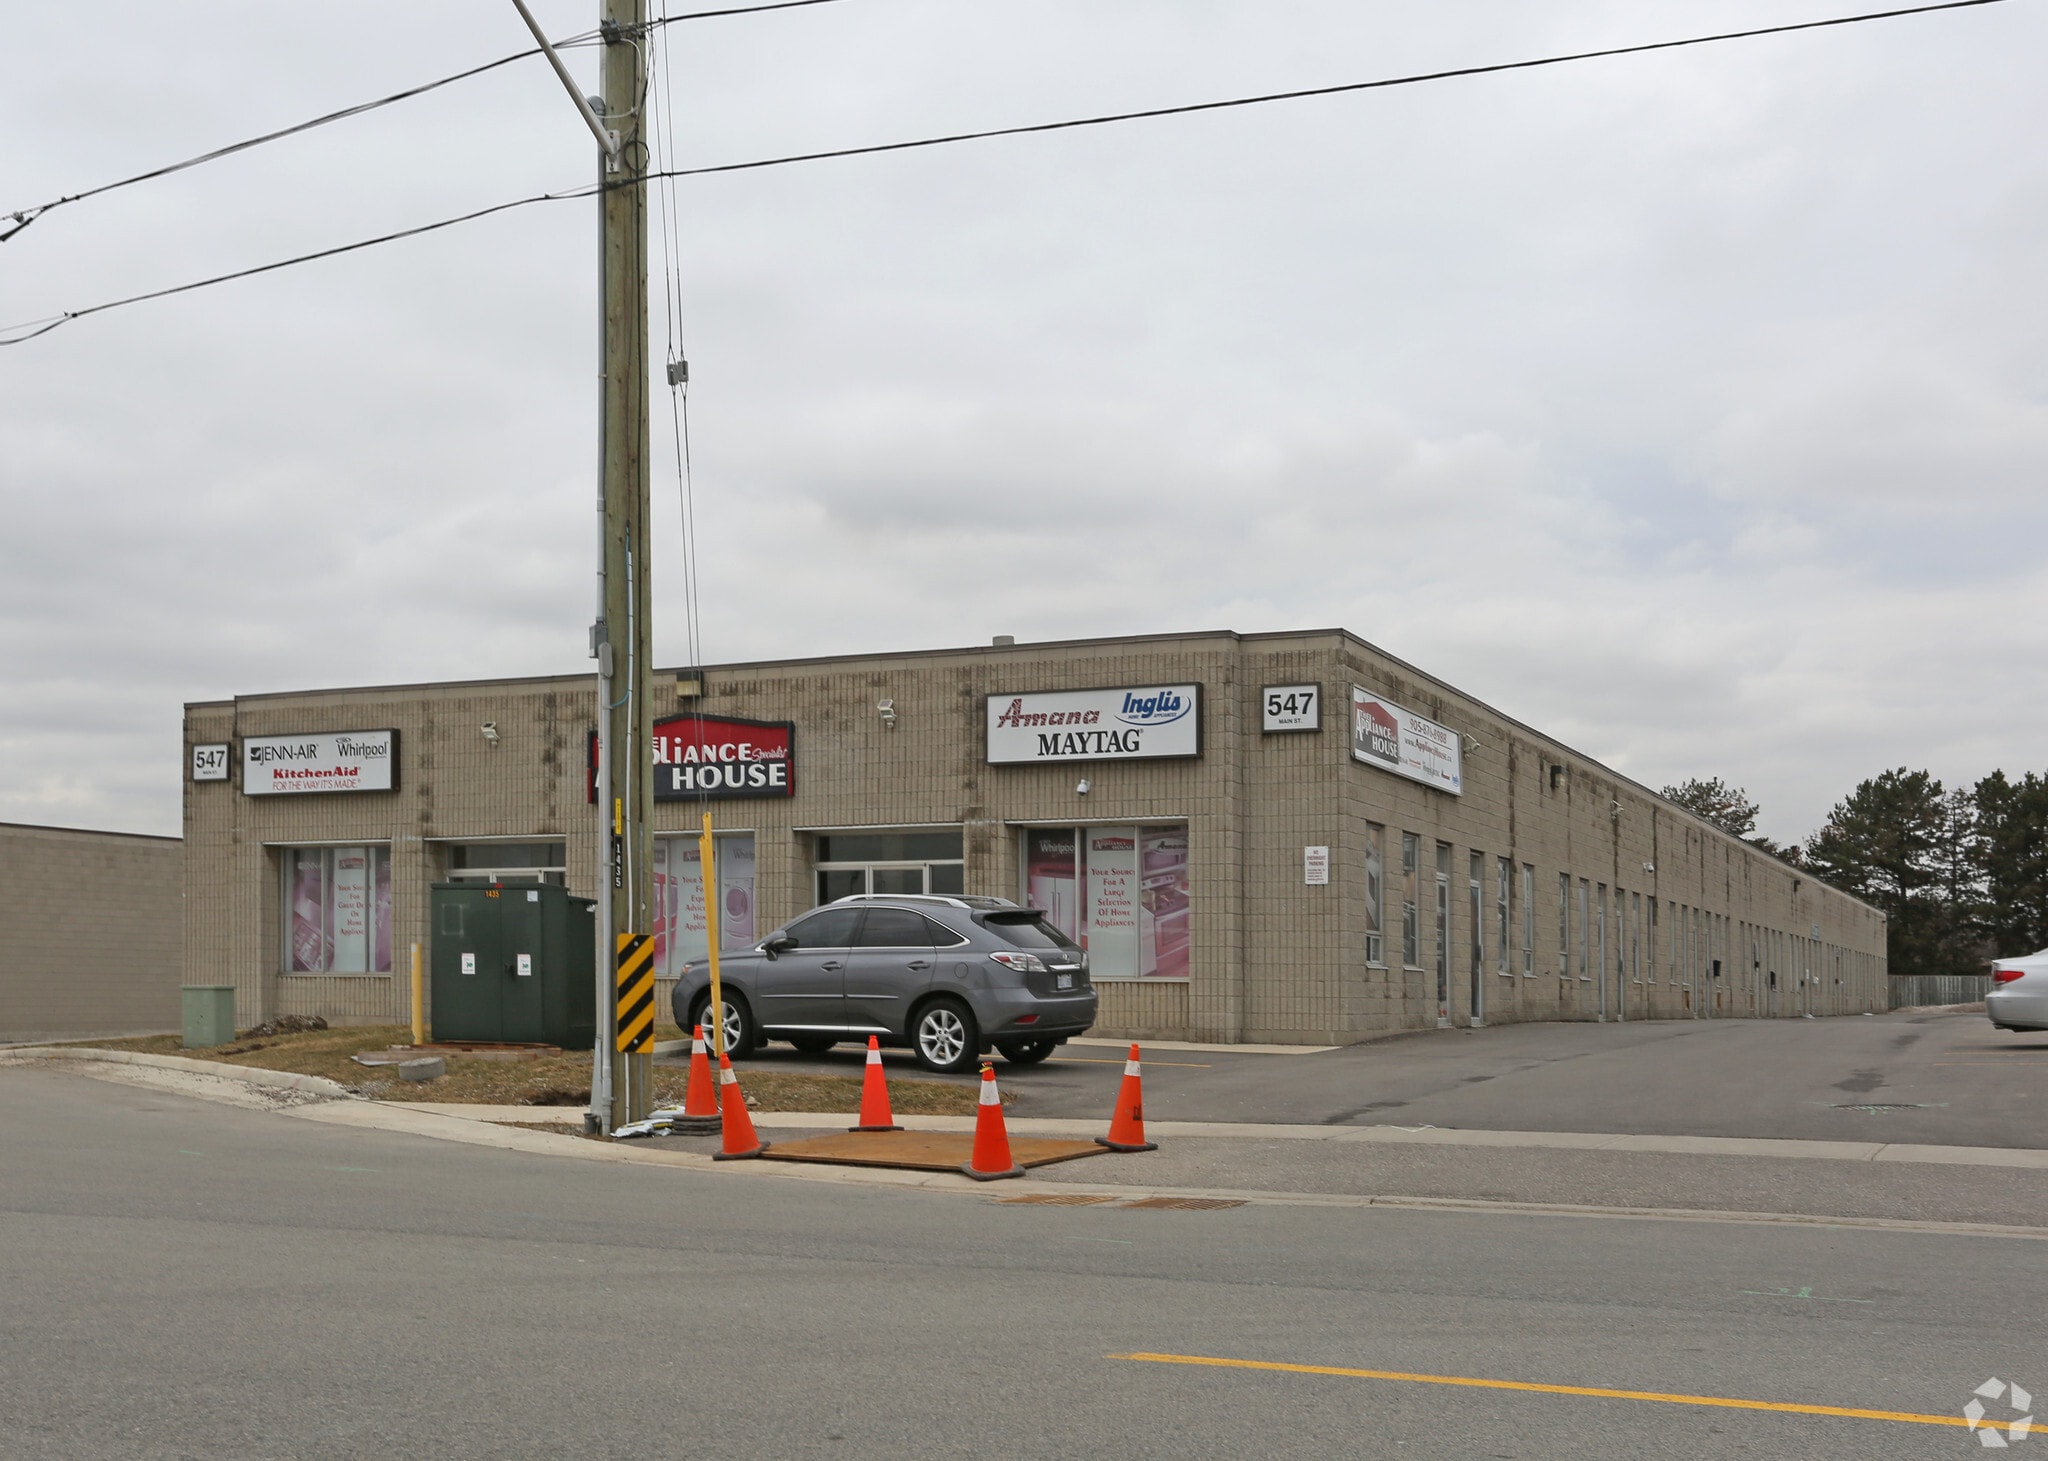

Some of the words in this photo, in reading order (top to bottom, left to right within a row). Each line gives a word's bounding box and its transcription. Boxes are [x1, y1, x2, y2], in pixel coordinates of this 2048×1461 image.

[997, 698, 1101, 728] Amana
[1121, 690, 1181, 719] Inglis
[1267, 693, 1314, 717] 547
[337, 741, 388, 760] Whirlpool
[1037, 729, 1140, 756] MAYTAG
[1372, 735, 1398, 758] HOUSE
[196, 750, 226, 768] 547
[260, 743, 318, 766] JENN-AIR
[272, 766, 359, 780] KitchenAid
[672, 763, 787, 790] HOUSE
[272, 782, 287, 791] FOR
[287, 781, 302, 790] THE
[303, 780, 320, 790] WAY
[1119, 878, 1126, 886] A
